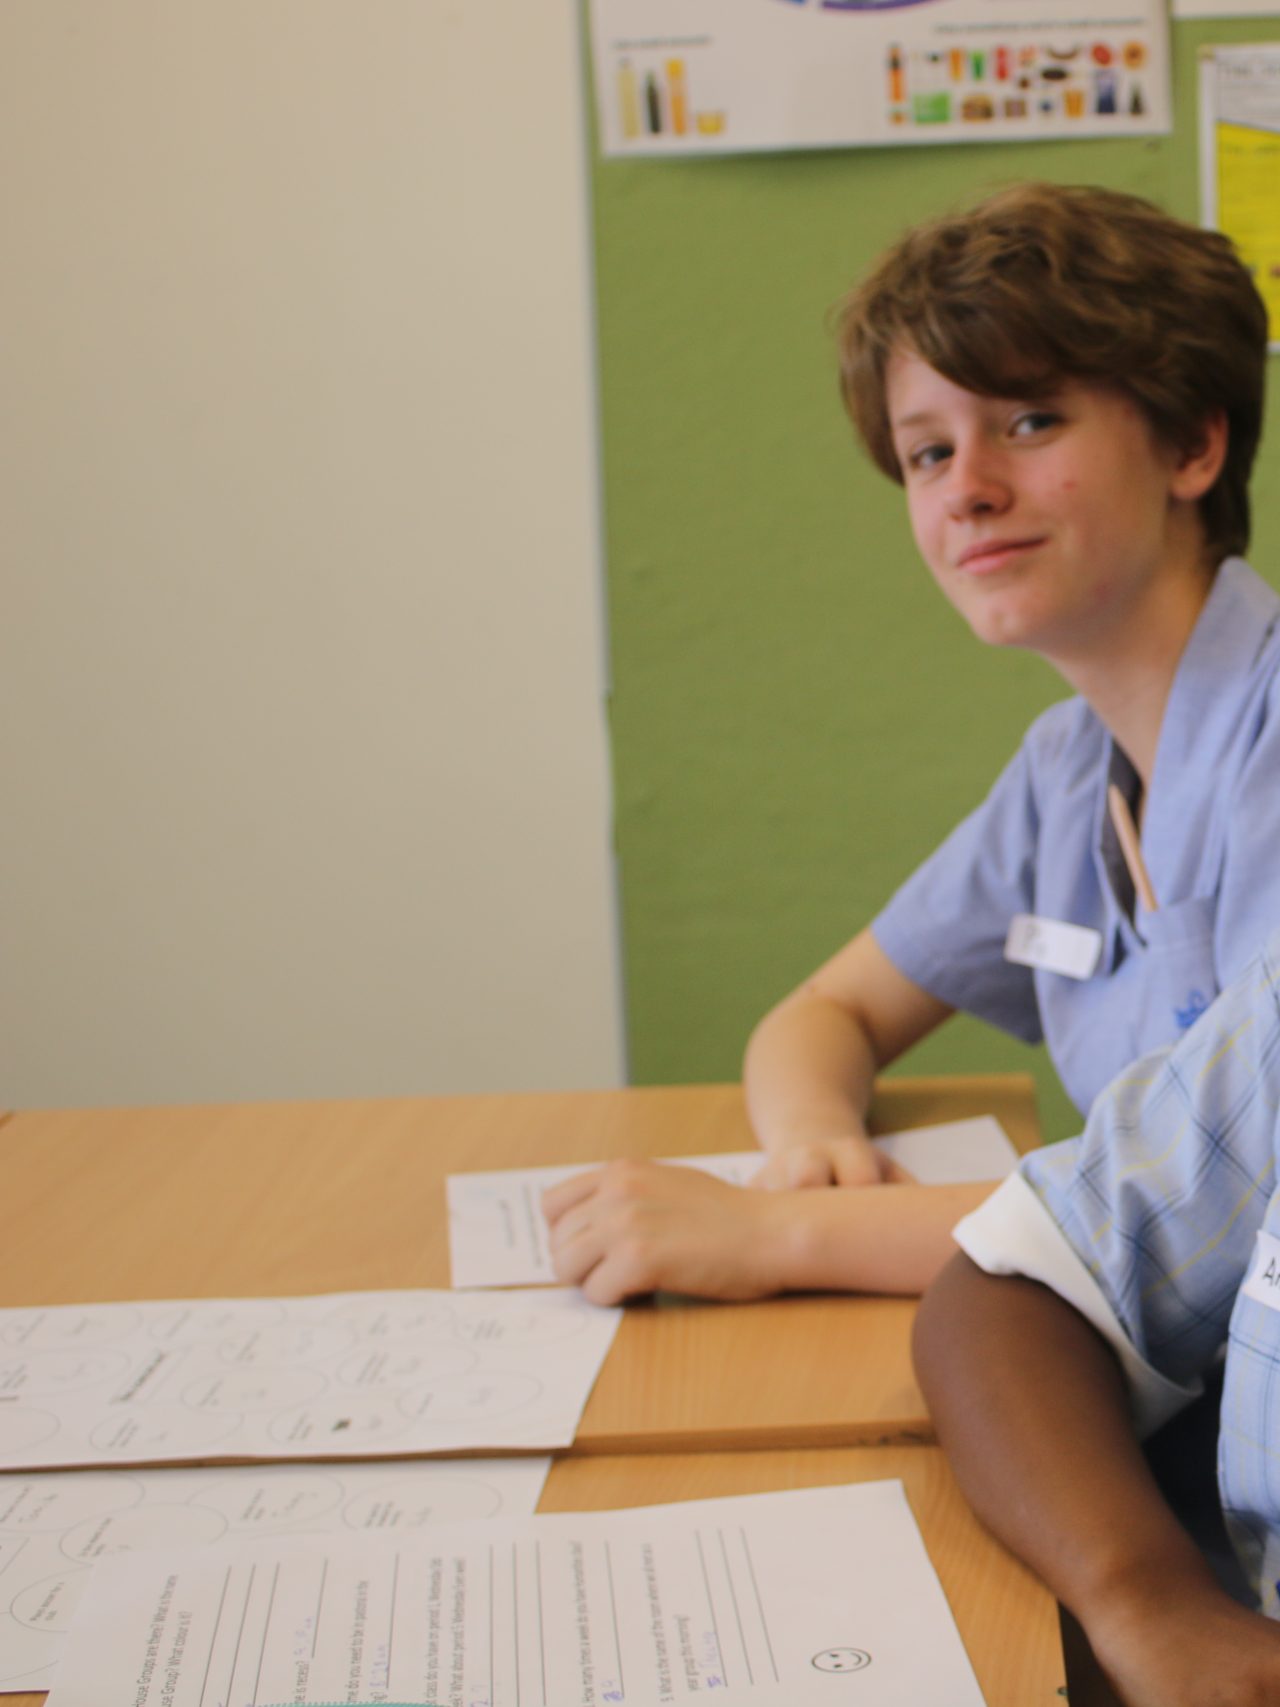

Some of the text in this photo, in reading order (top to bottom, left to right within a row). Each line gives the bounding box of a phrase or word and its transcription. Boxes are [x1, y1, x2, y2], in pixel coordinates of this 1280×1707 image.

[152, 1606, 168, 1623] What
[145, 1623, 164, 1645] there?
[173, 1627, 189, 1647] colour
[146, 1646, 160, 1658] are
[167, 1648, 184, 1667] What
[136, 1658, 157, 1684] Groups
[349, 1666, 363, 1680] you
[428, 1657, 441, 1670] you
[160, 1667, 182, 1695] Group?
[295, 1660, 310, 1687] recess?
[657, 1676, 673, 1694] What
